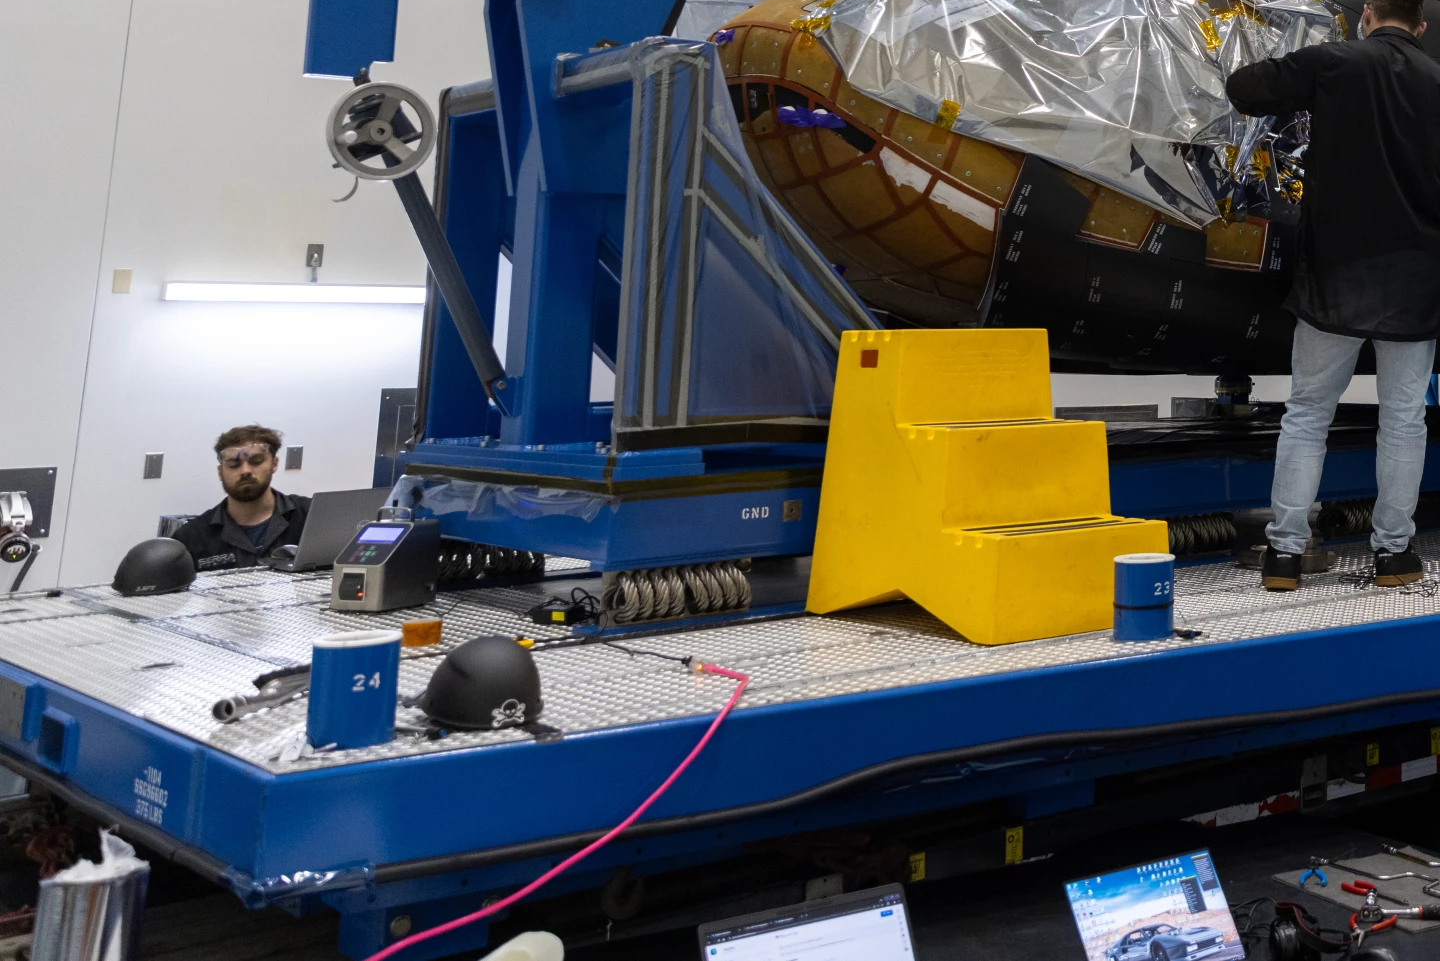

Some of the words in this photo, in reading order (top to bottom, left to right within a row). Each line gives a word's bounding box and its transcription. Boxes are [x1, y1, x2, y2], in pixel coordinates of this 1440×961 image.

[742, 506, 769, 520] GND
[1154, 581, 1170, 596] 23
[352, 671, 381, 692] 24
